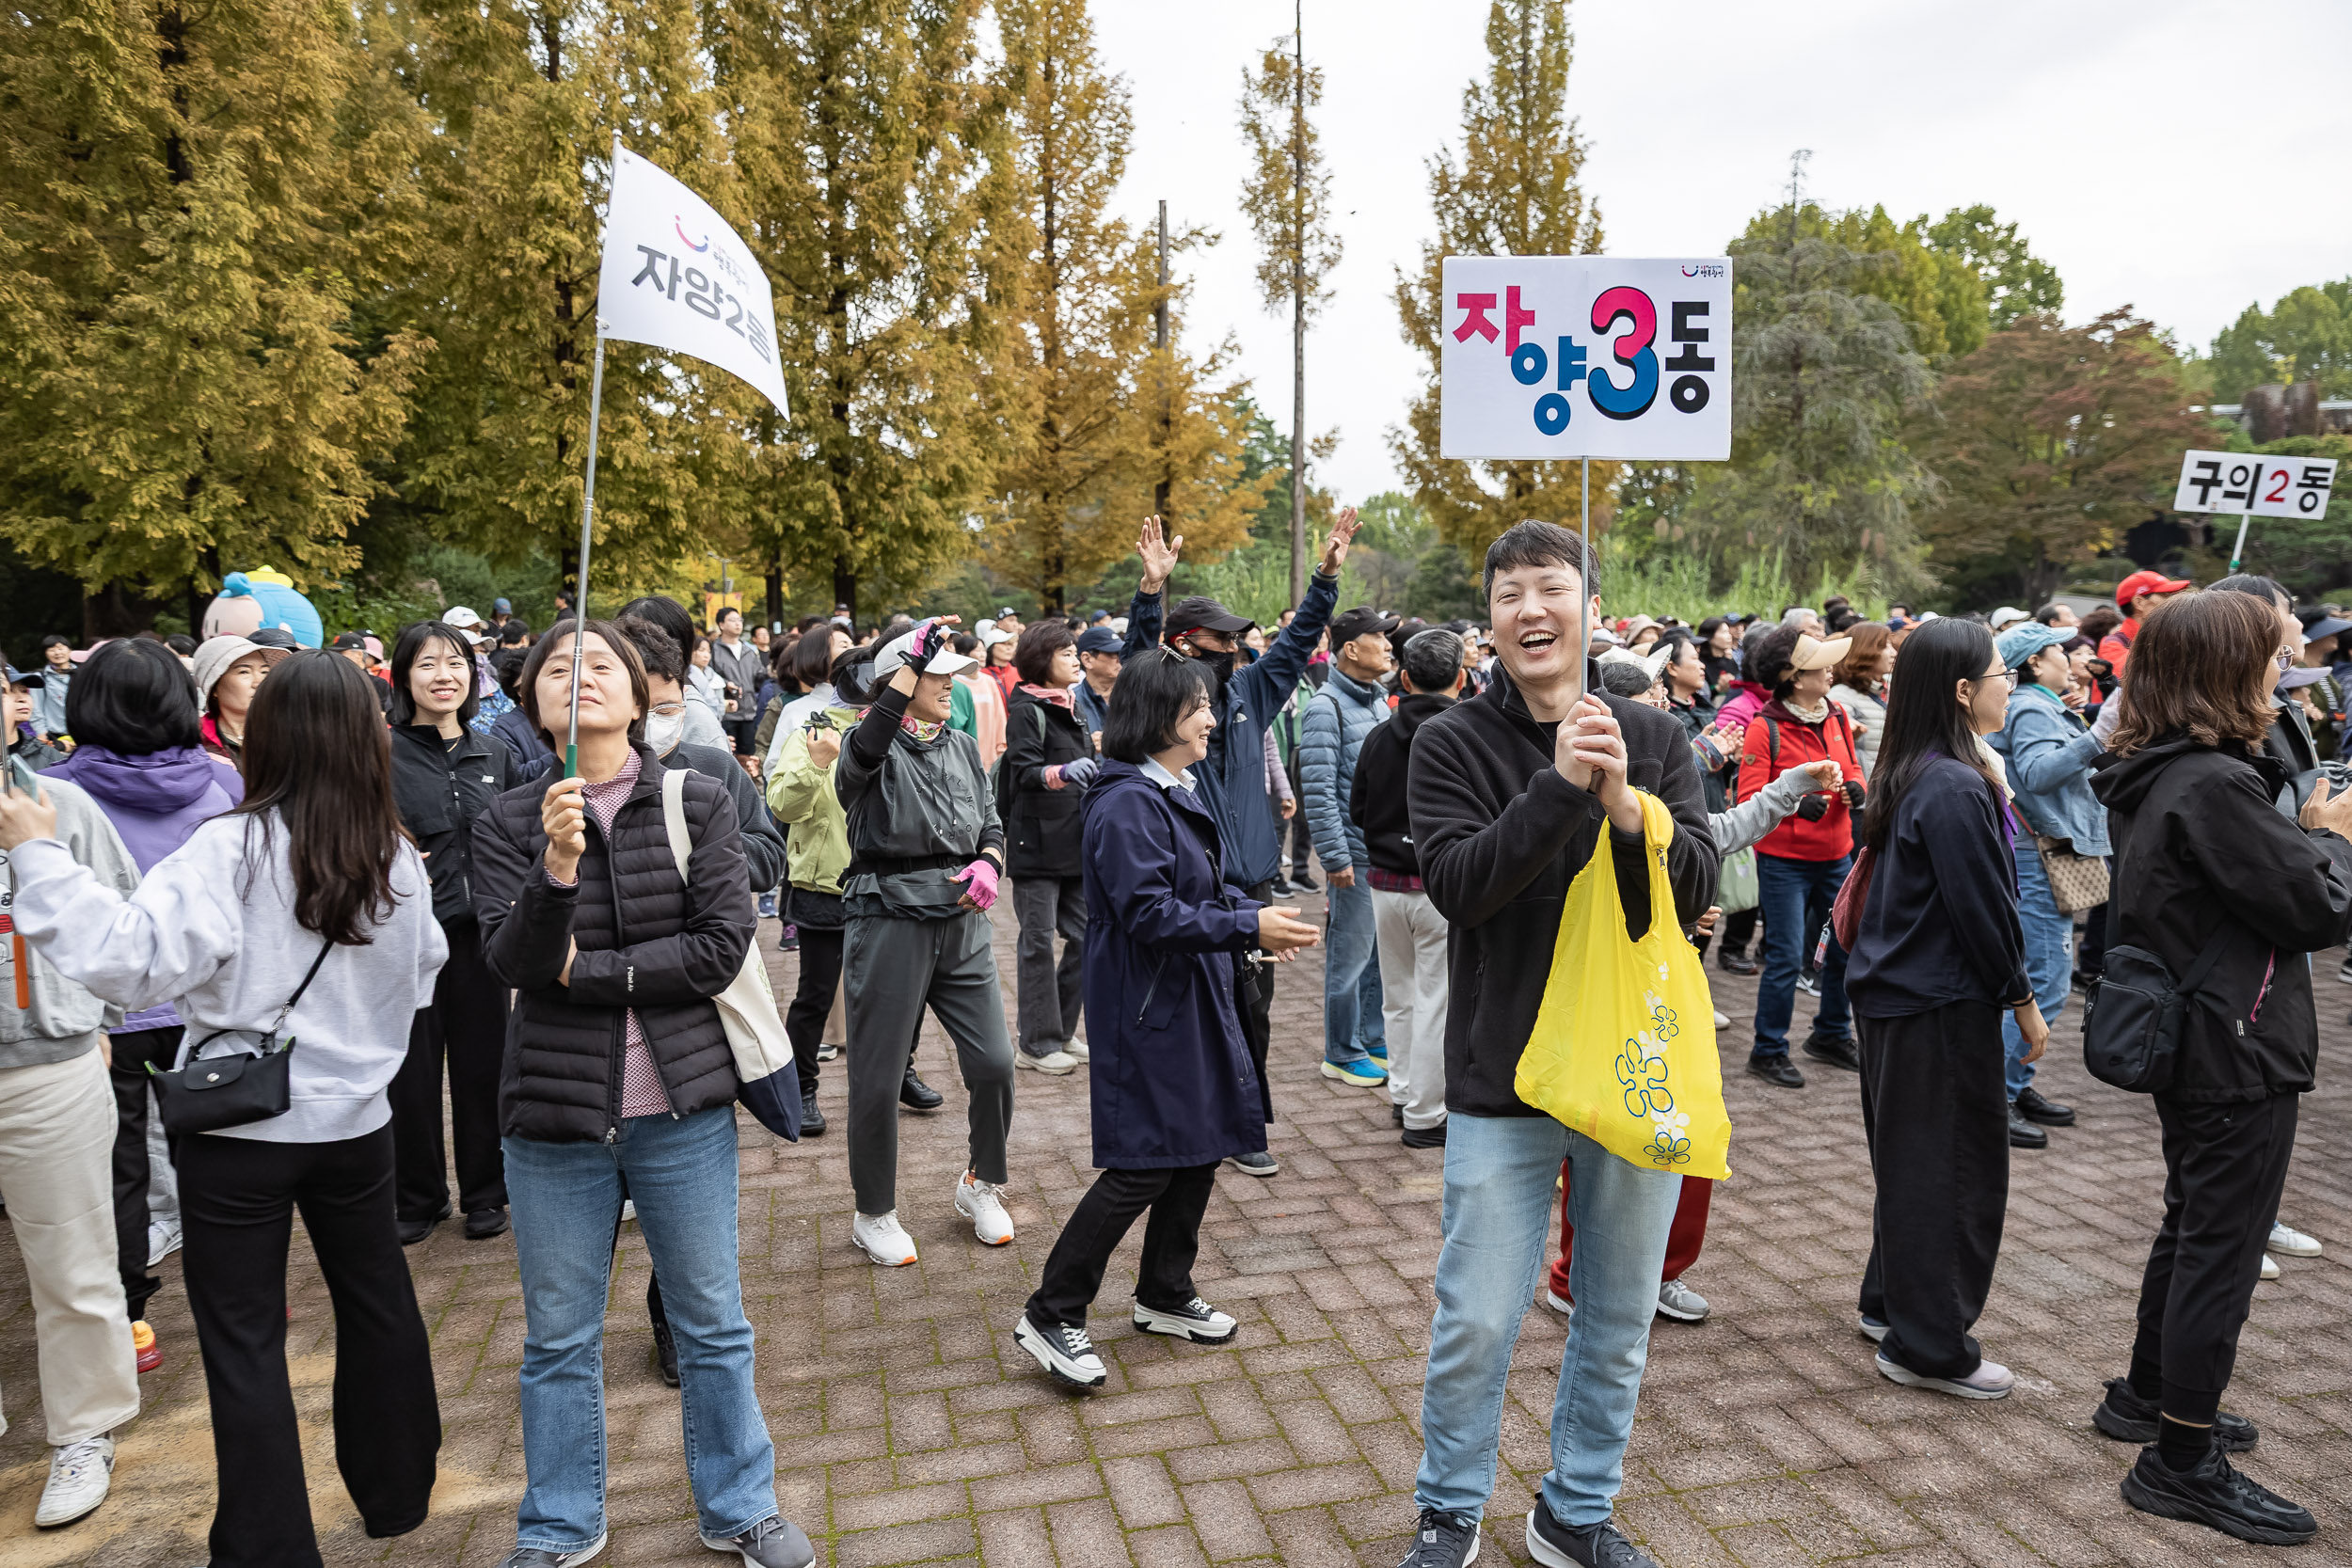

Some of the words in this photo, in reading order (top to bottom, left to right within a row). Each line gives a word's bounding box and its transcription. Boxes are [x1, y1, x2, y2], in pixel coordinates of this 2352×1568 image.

[631, 244, 771, 365] 자양2동
[1452, 285, 1715, 436] 자양3동
[2189, 460, 2332, 514] 구의2동
